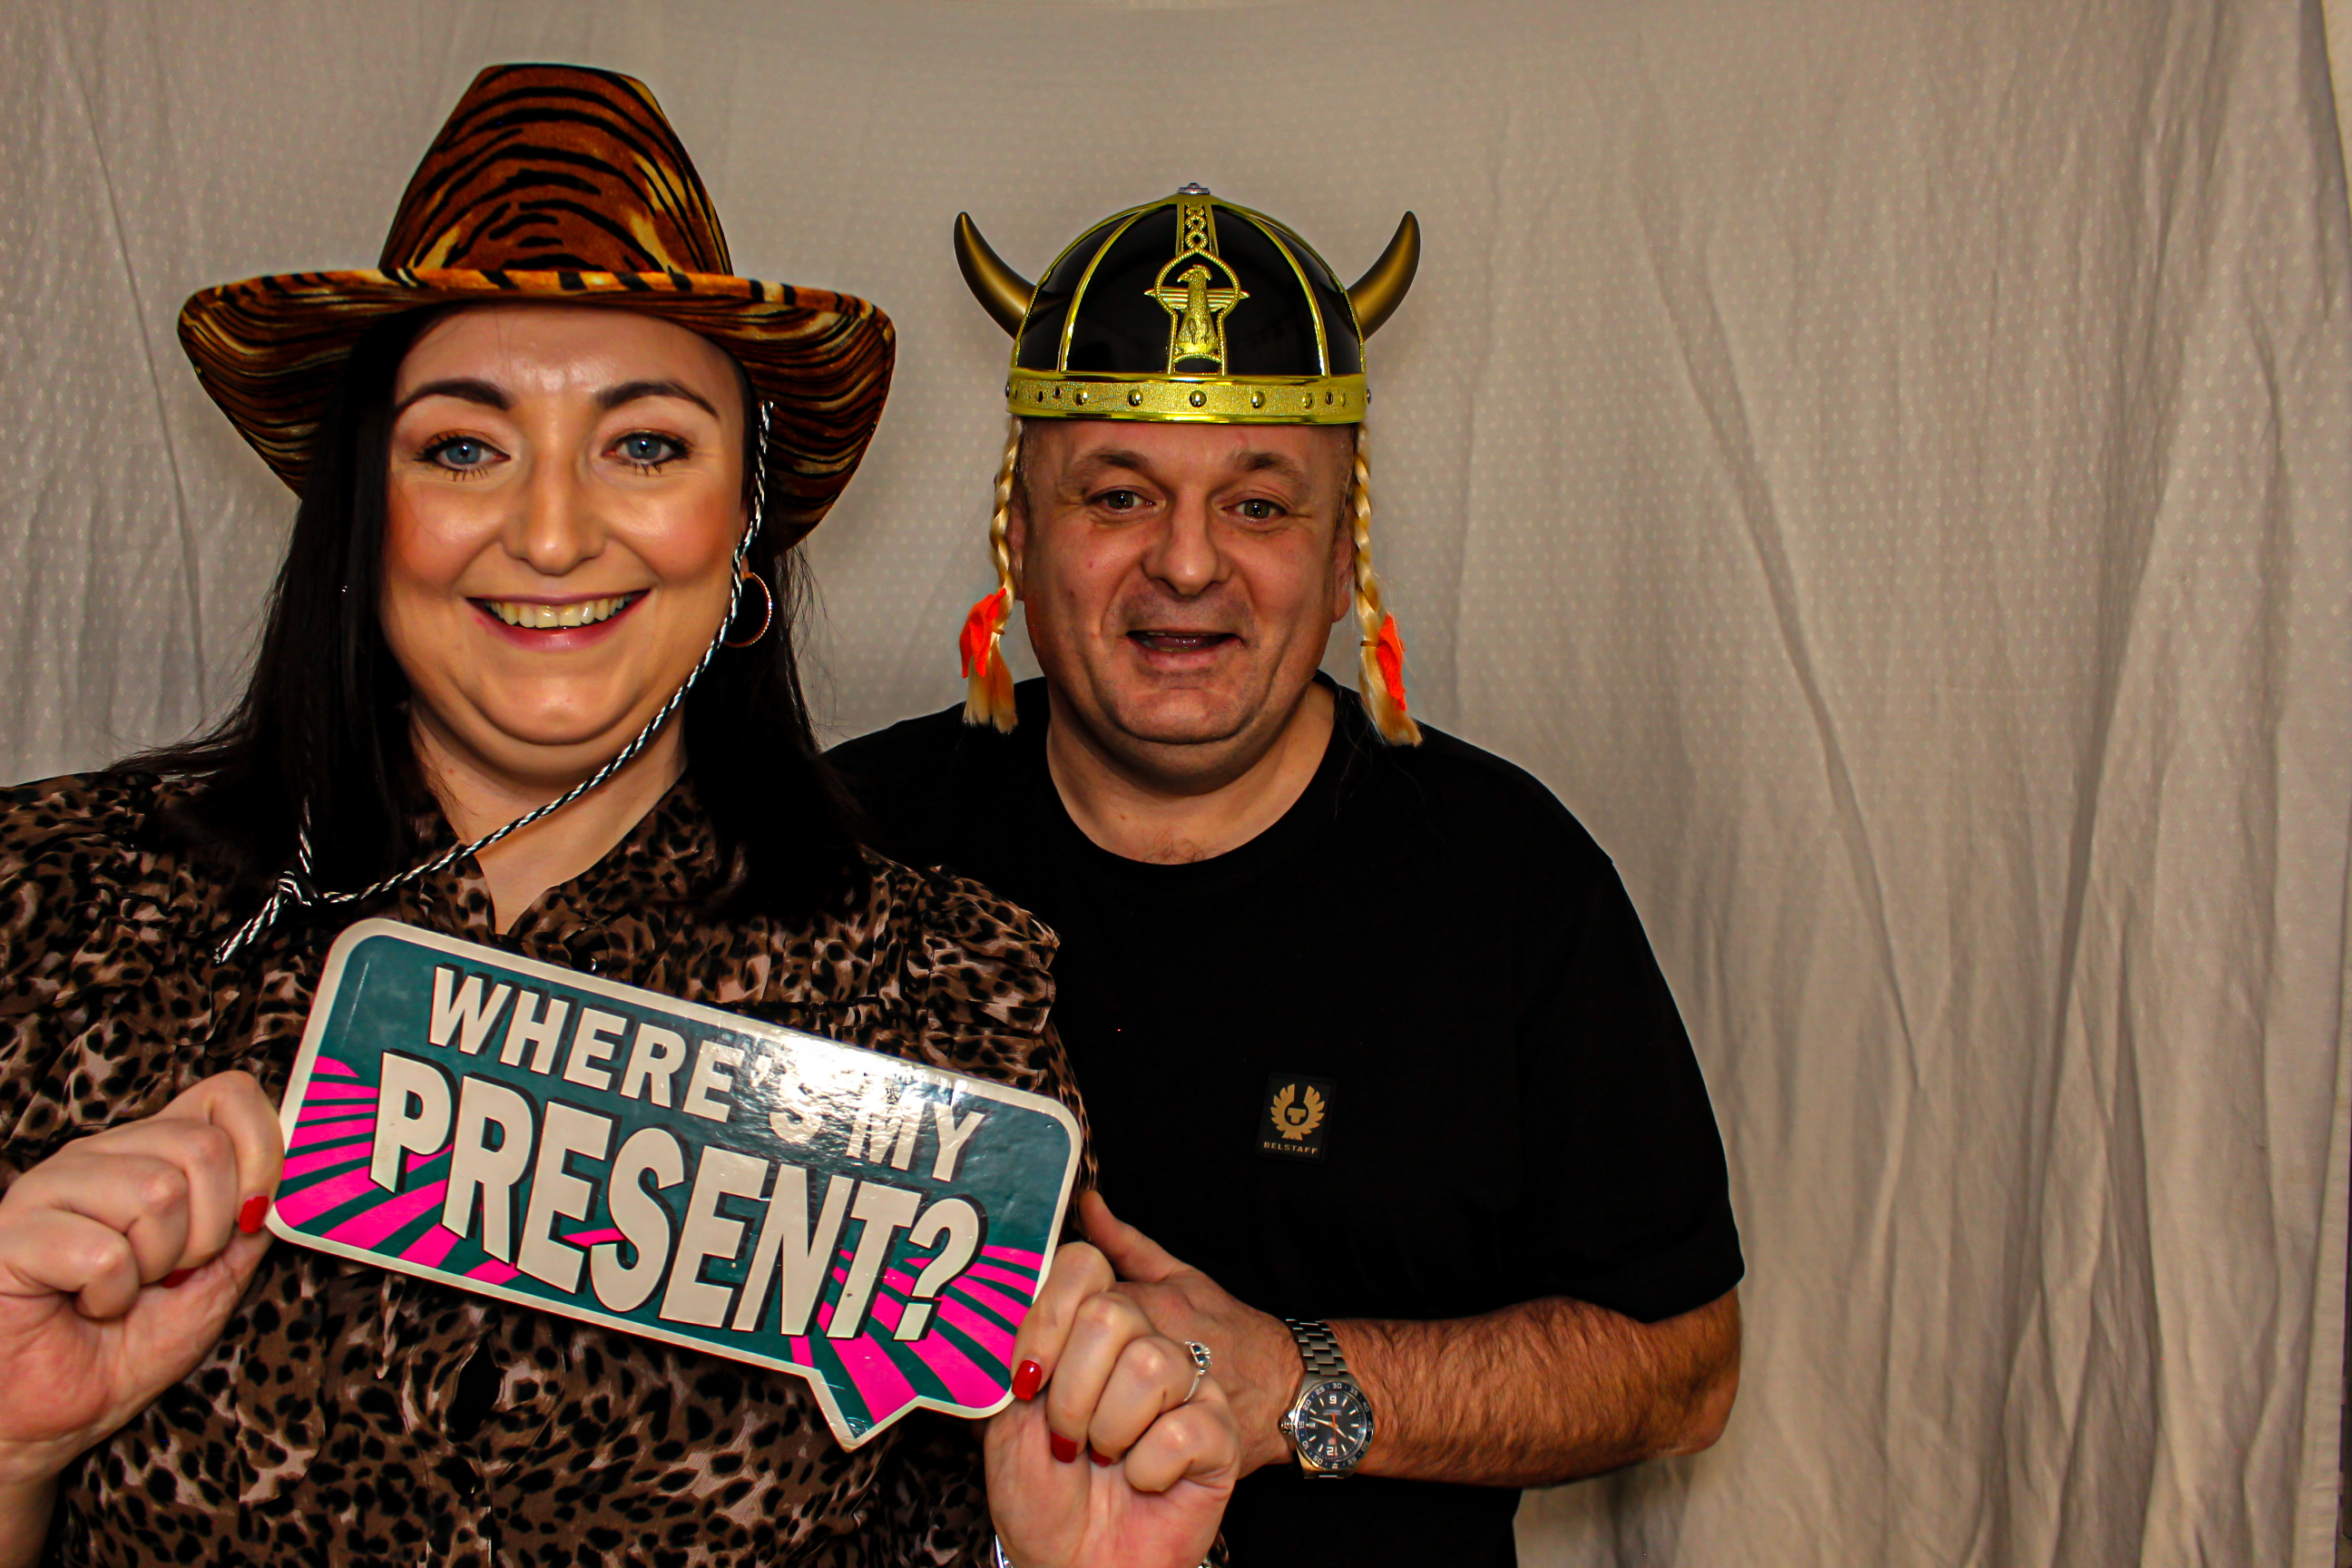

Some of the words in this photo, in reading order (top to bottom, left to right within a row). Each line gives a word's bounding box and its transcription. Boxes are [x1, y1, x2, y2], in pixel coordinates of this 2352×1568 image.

[428, 965, 833, 1147] WHERE'S
[845, 1078, 987, 1183] MY
[1263, 1142, 1318, 1154] BELSTAFF
[369, 1050, 985, 1341] PRESENT?
[1303, 1399, 1312, 1411] 20
[1327, 1446, 1338, 1456] 12
